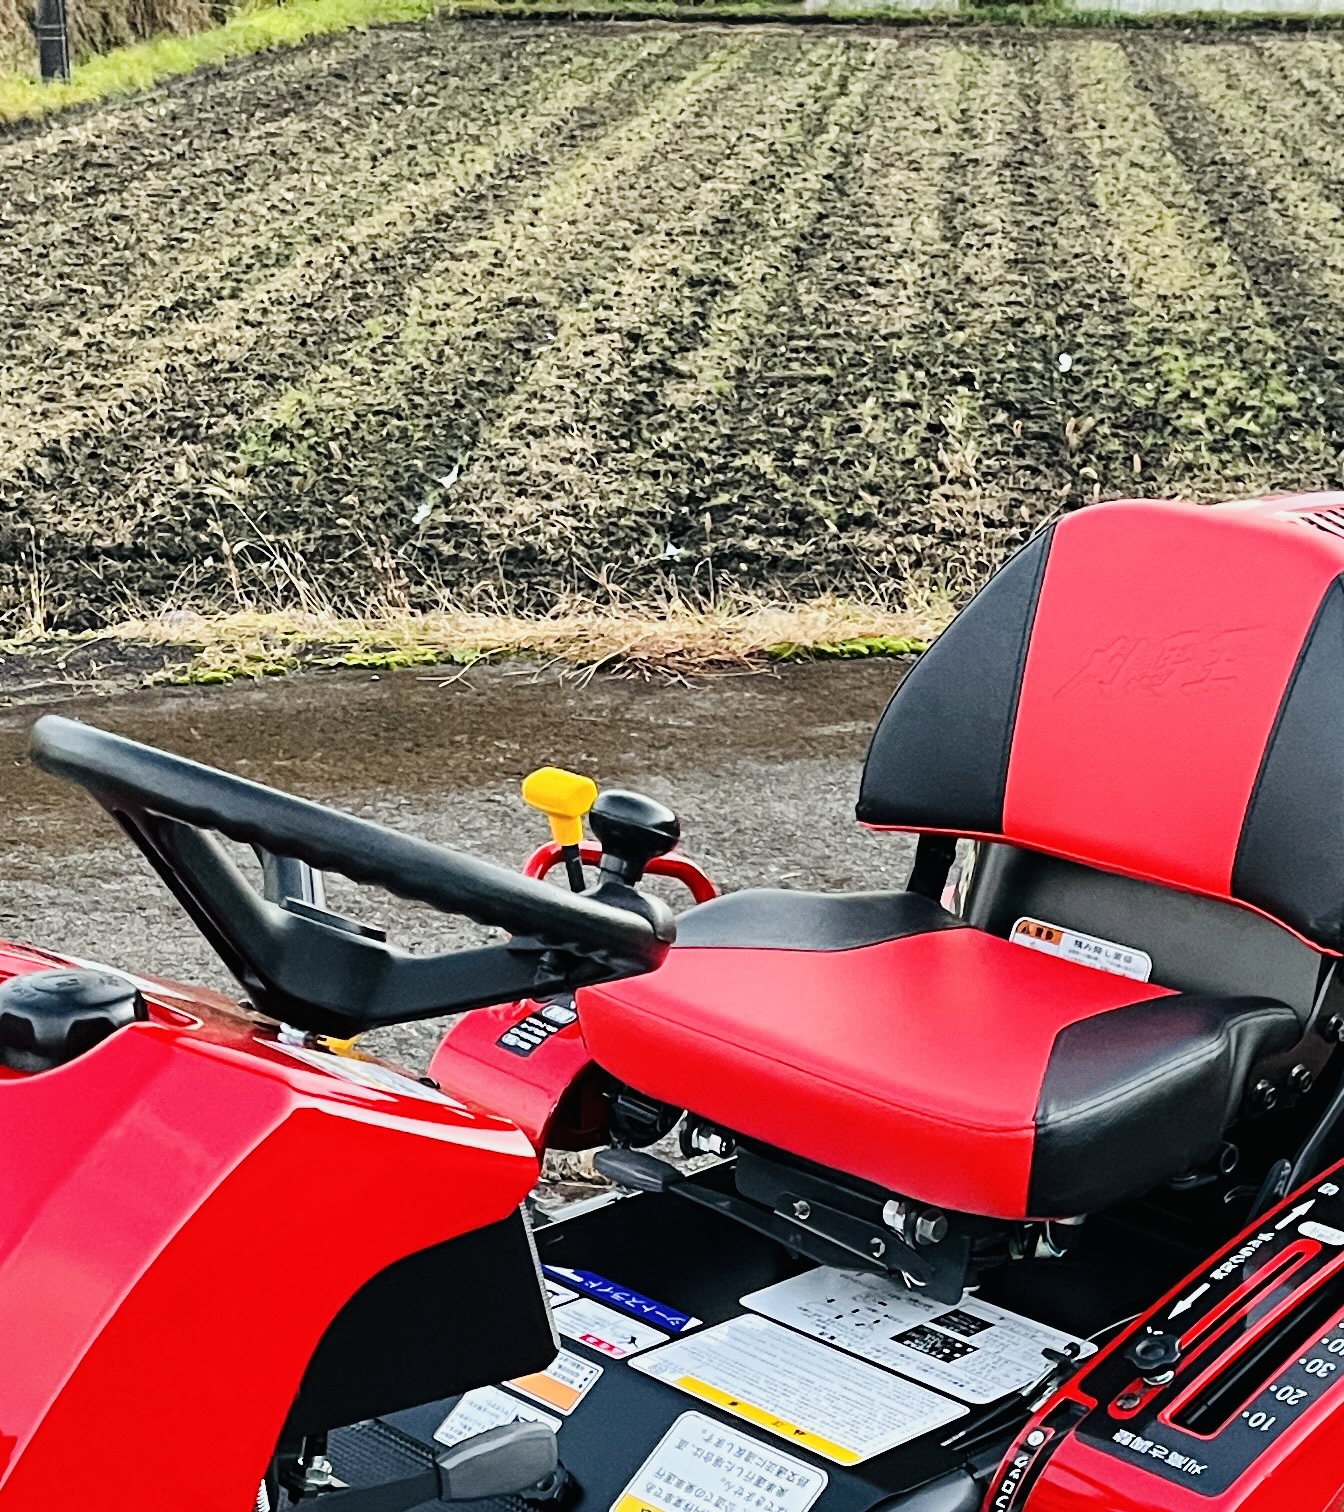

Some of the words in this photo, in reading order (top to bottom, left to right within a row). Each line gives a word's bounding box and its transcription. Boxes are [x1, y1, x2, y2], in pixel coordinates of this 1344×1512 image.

[582, 1281, 687, 1330] シートスライド
[1306, 1358, 1336, 1377] 30
[1278, 1384, 1307, 1405] 20
[1247, 1412, 1277, 1433] 10
[1112, 1429, 1208, 1475] 刈高さ調整
